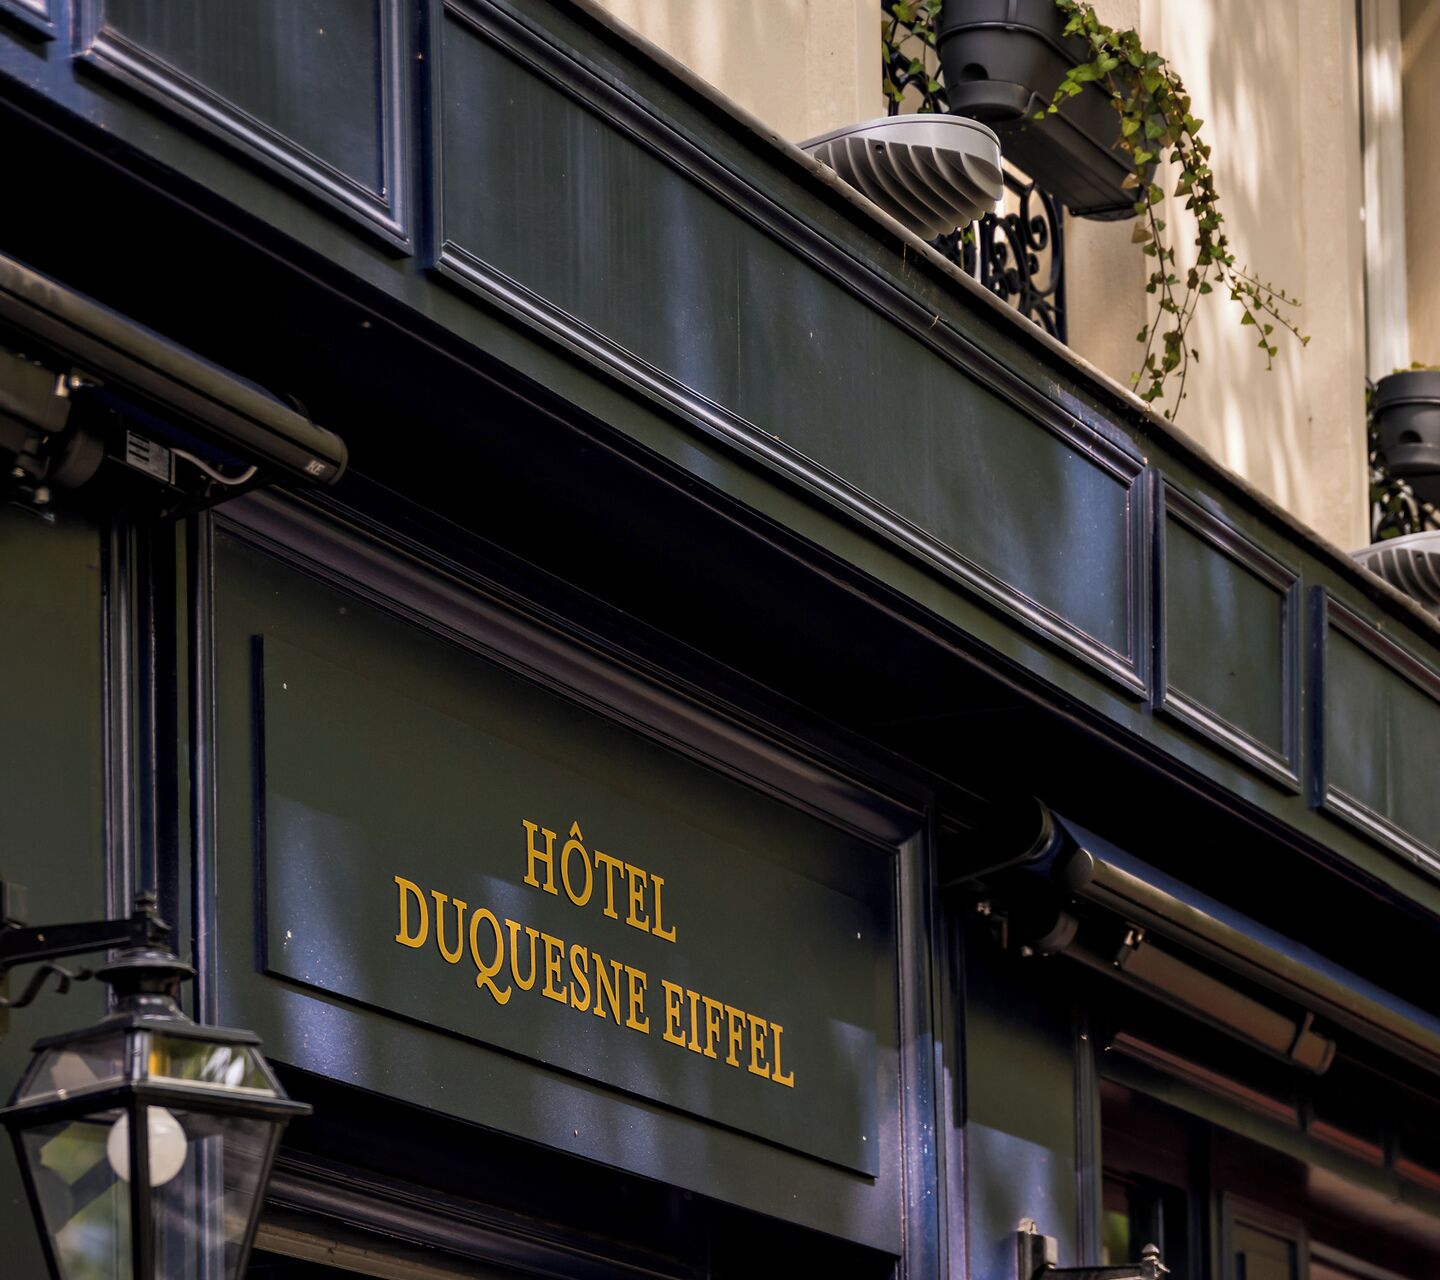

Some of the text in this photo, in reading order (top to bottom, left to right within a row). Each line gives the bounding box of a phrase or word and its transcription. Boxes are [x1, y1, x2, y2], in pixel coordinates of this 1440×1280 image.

[522, 819, 676, 943] HÔTEL
[394, 875, 795, 1088] DUQUESNE EIFFEL
